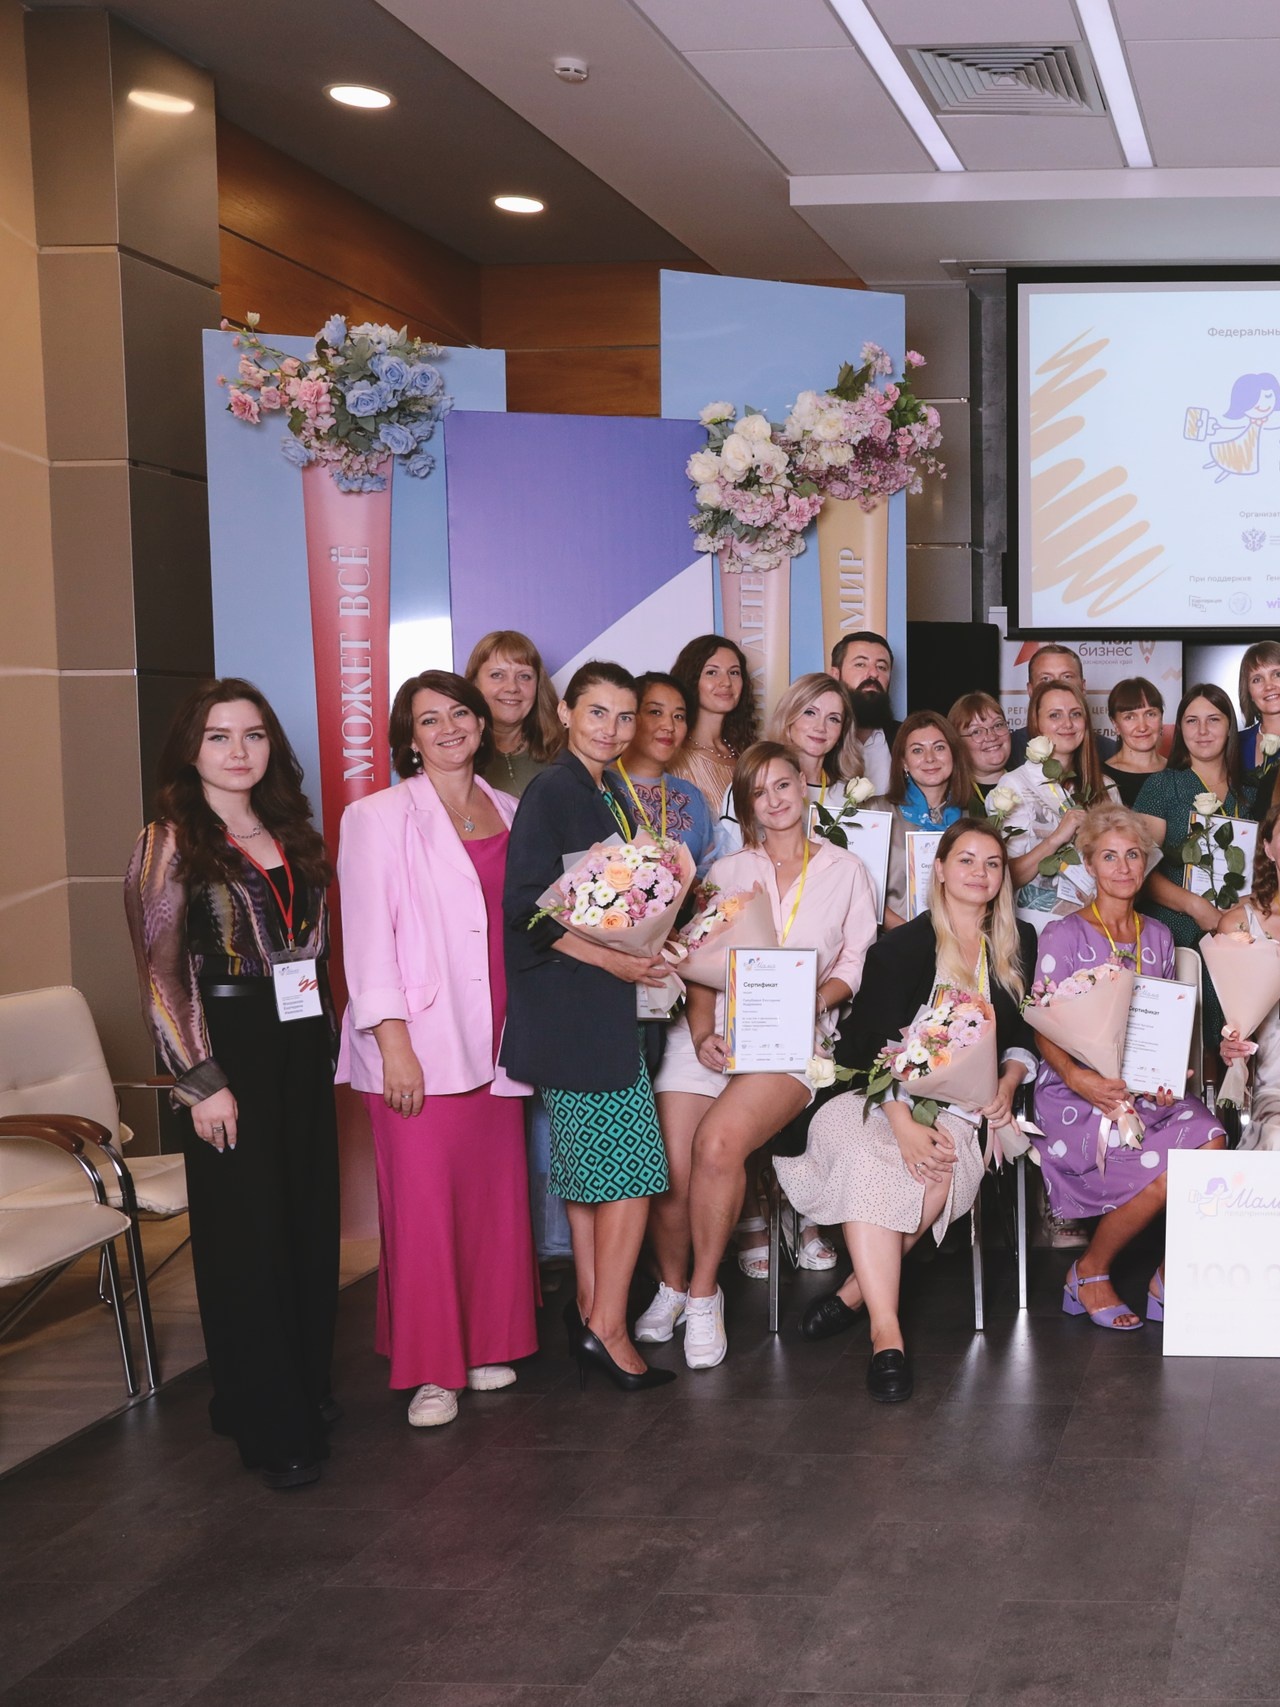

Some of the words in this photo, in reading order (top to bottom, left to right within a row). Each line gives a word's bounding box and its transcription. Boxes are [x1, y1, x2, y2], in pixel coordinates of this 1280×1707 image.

[330, 546, 371, 618] ВСЁ
[839, 548, 865, 630] МИР
[1078, 643, 1133, 657] бизнес
[339, 632, 375, 782] МОЖЕТ
